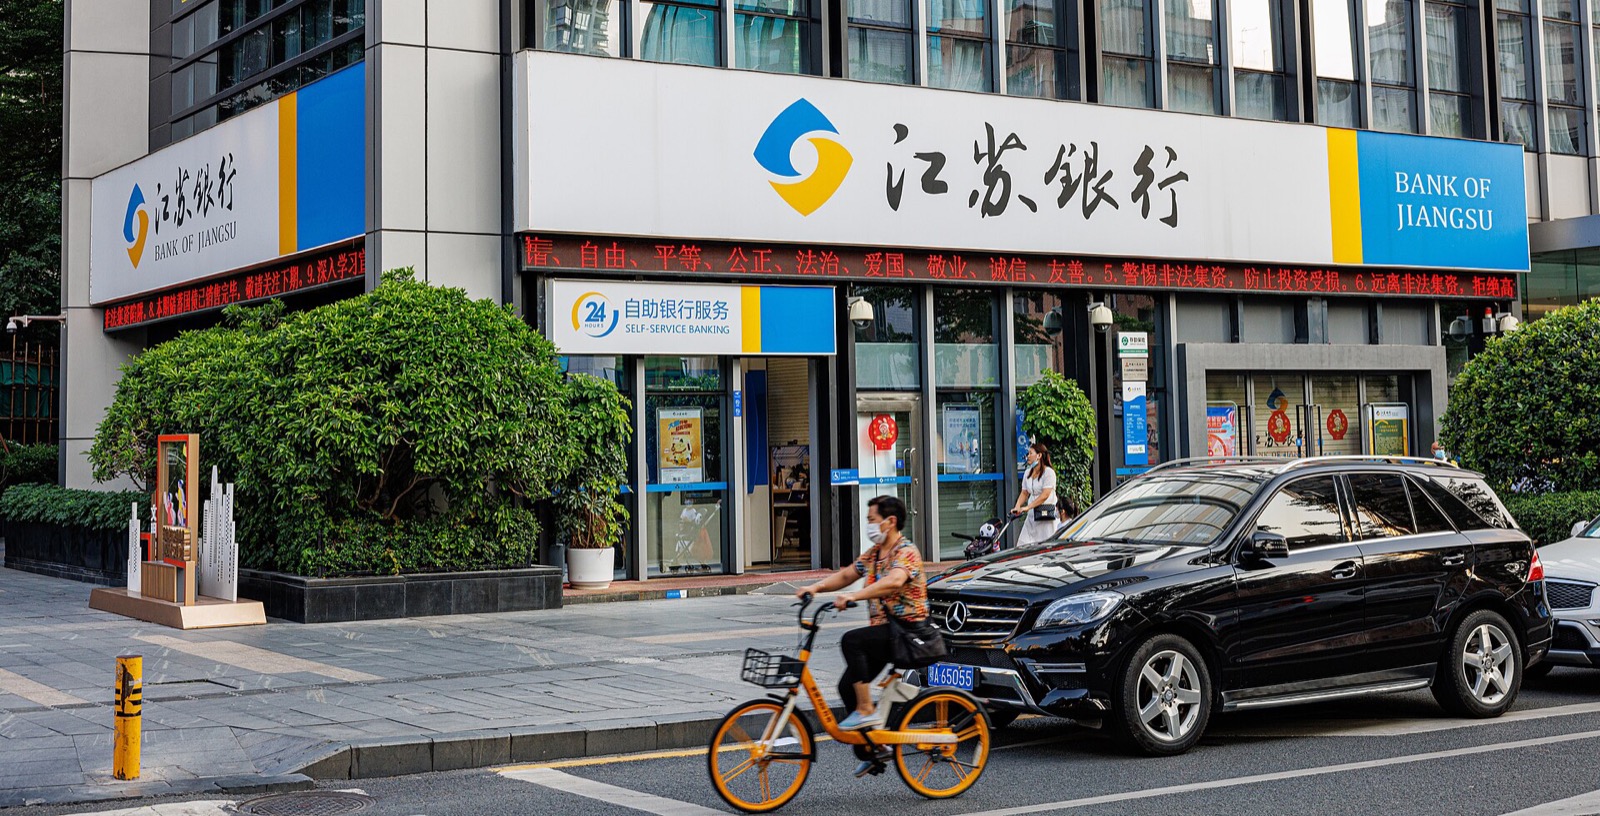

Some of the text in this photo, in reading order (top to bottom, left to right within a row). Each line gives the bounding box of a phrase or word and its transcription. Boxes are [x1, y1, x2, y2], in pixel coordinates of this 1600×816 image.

[1395, 171, 1491, 199] BANK OF
[1397, 203, 1493, 231] JIANGSU
[154, 220, 237, 262] BANK OF JIANGSU
[584, 301, 607, 323] 24
[625, 297, 729, 321] 自助银行服务
[625, 323, 730, 335] SELF-SERVICE BANKING
